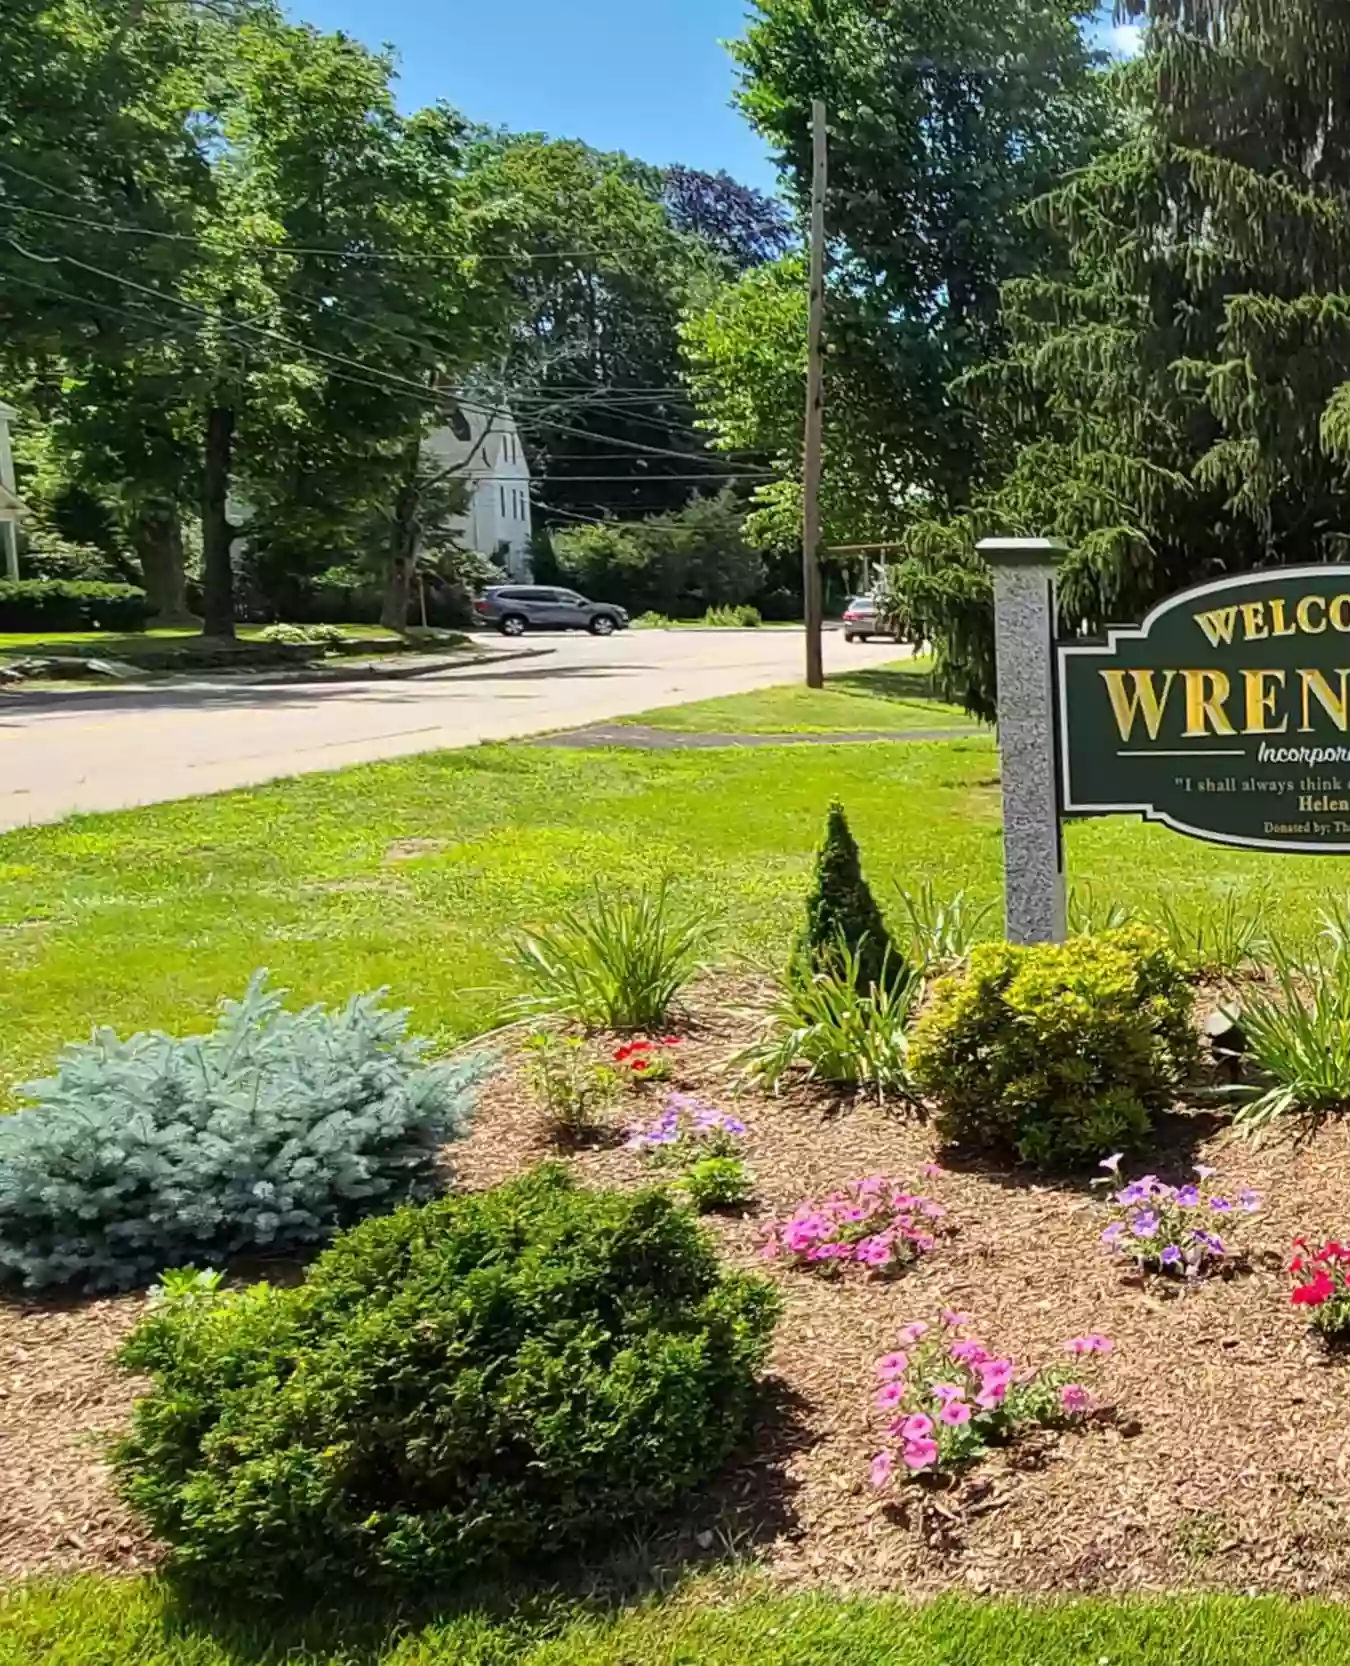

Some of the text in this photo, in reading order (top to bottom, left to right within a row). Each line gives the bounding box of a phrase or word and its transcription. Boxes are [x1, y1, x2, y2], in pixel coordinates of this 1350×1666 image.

[1174, 777, 1192, 792] "I
[1197, 777, 1237, 792] shall
[1241, 777, 1295, 795] always
[1299, 776, 1342, 791] think
[1298, 795, 1350, 812] Helen
[1263, 821, 1311, 834] Donated
